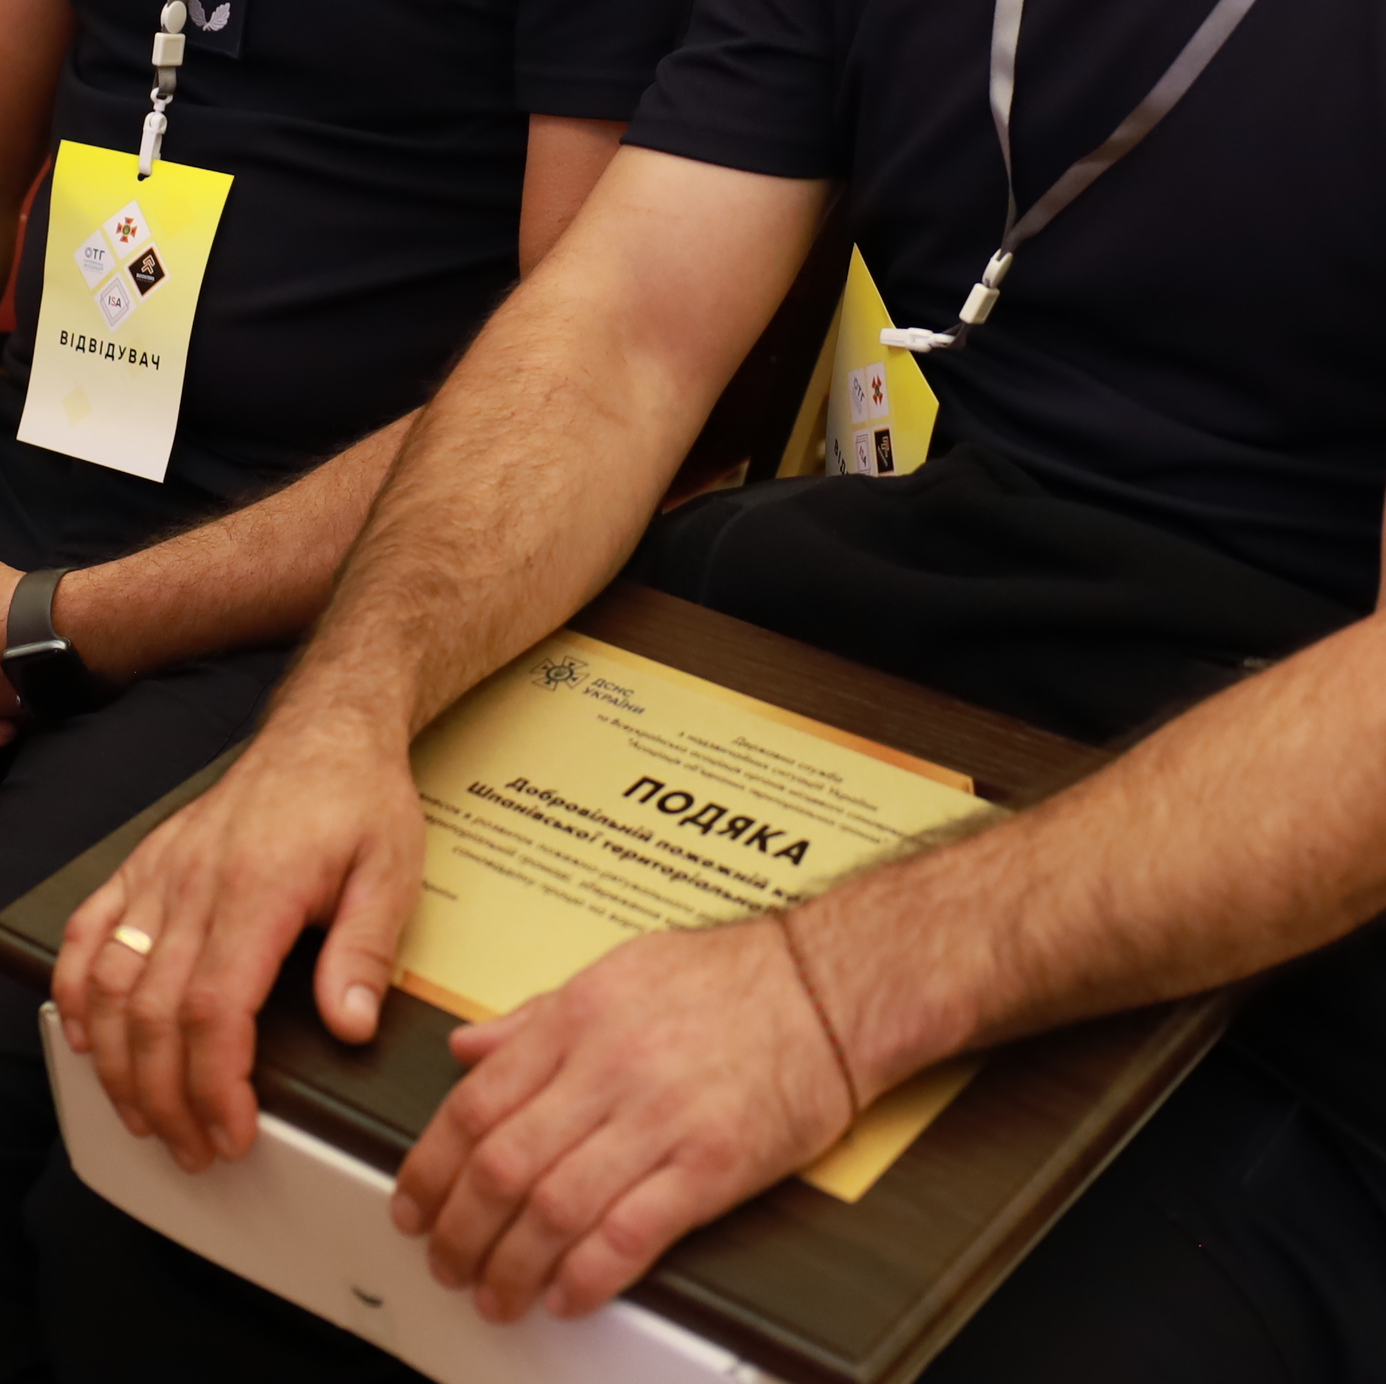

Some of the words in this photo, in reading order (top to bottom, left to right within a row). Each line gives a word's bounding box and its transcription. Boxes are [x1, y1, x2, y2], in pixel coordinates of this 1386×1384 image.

[108, 295, 122, 308] ISA
[60, 329, 161, 370] ВІДВІДУВАЧ
[465, 781, 605, 844] Шпанівської
[503, 775, 656, 843] Добровільній
[654, 838, 772, 890] пожежній
[620, 774, 811, 866] ПОДЯКА
